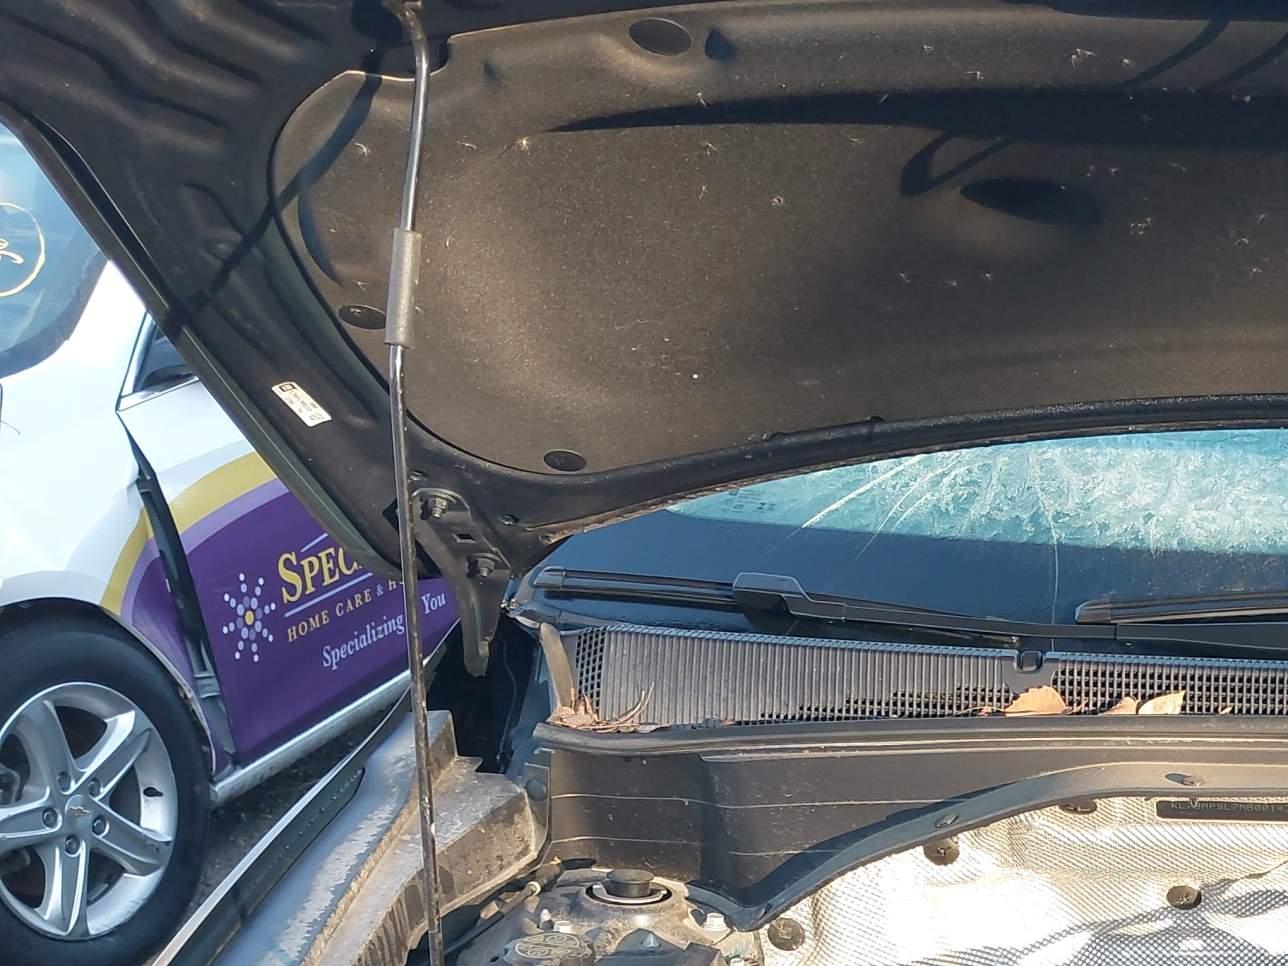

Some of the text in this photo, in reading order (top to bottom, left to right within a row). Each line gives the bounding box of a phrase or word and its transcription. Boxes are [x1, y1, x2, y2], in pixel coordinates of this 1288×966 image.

[278, 546, 362, 604] SPEC
[287, 610, 330, 642] HOME
[335, 588, 373, 617] CARE
[376, 583, 384, 596] &
[322, 592, 446, 671] Specializing You
